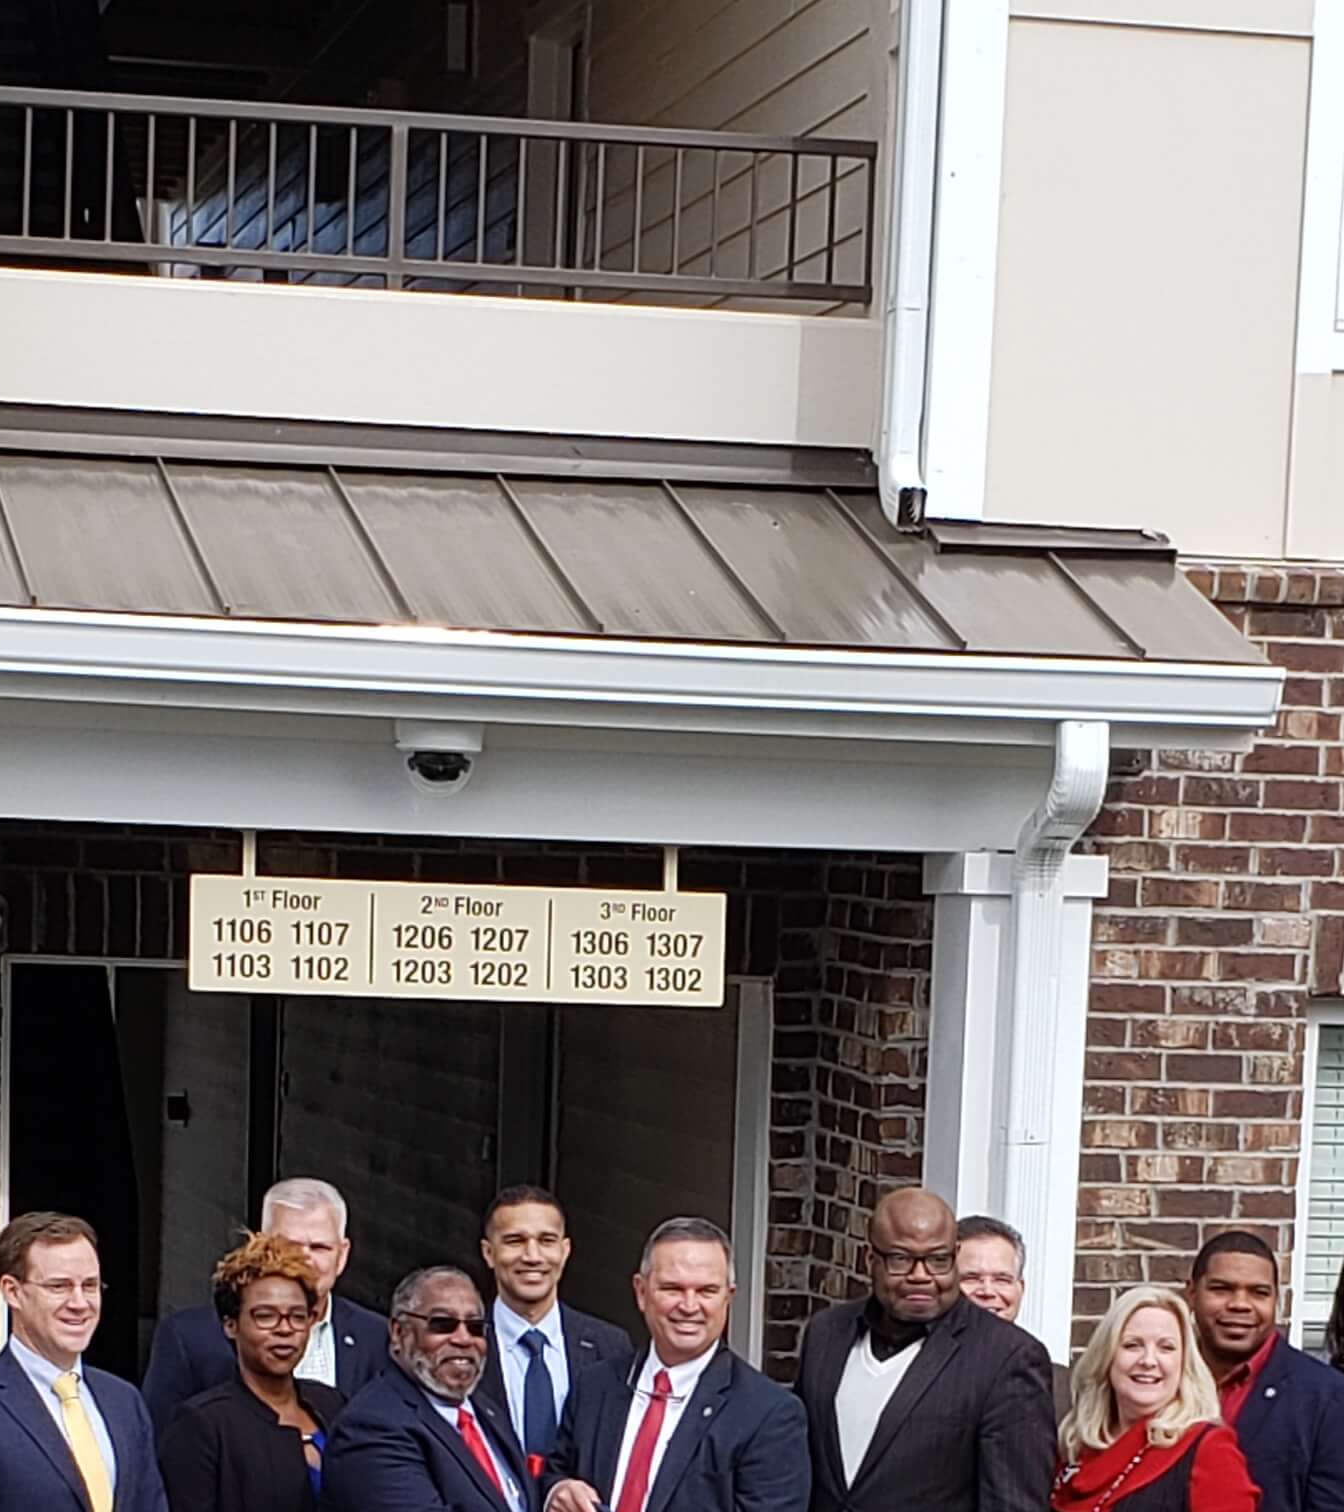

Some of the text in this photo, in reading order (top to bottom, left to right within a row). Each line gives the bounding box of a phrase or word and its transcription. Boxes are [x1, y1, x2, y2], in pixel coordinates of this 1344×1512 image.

[243, 889, 321, 911] 1ST Floor
[421, 895, 504, 917] 2ND Floor
[631, 903, 676, 922] Floor
[213, 917, 350, 946] 1106 1107
[392, 924, 529, 953] 1206 1207
[571, 930, 704, 958] 1306 1307
[212, 952, 349, 981] 1103 1102
[391, 959, 528, 987] 1203 1202
[570, 964, 702, 992] 1303 1302
